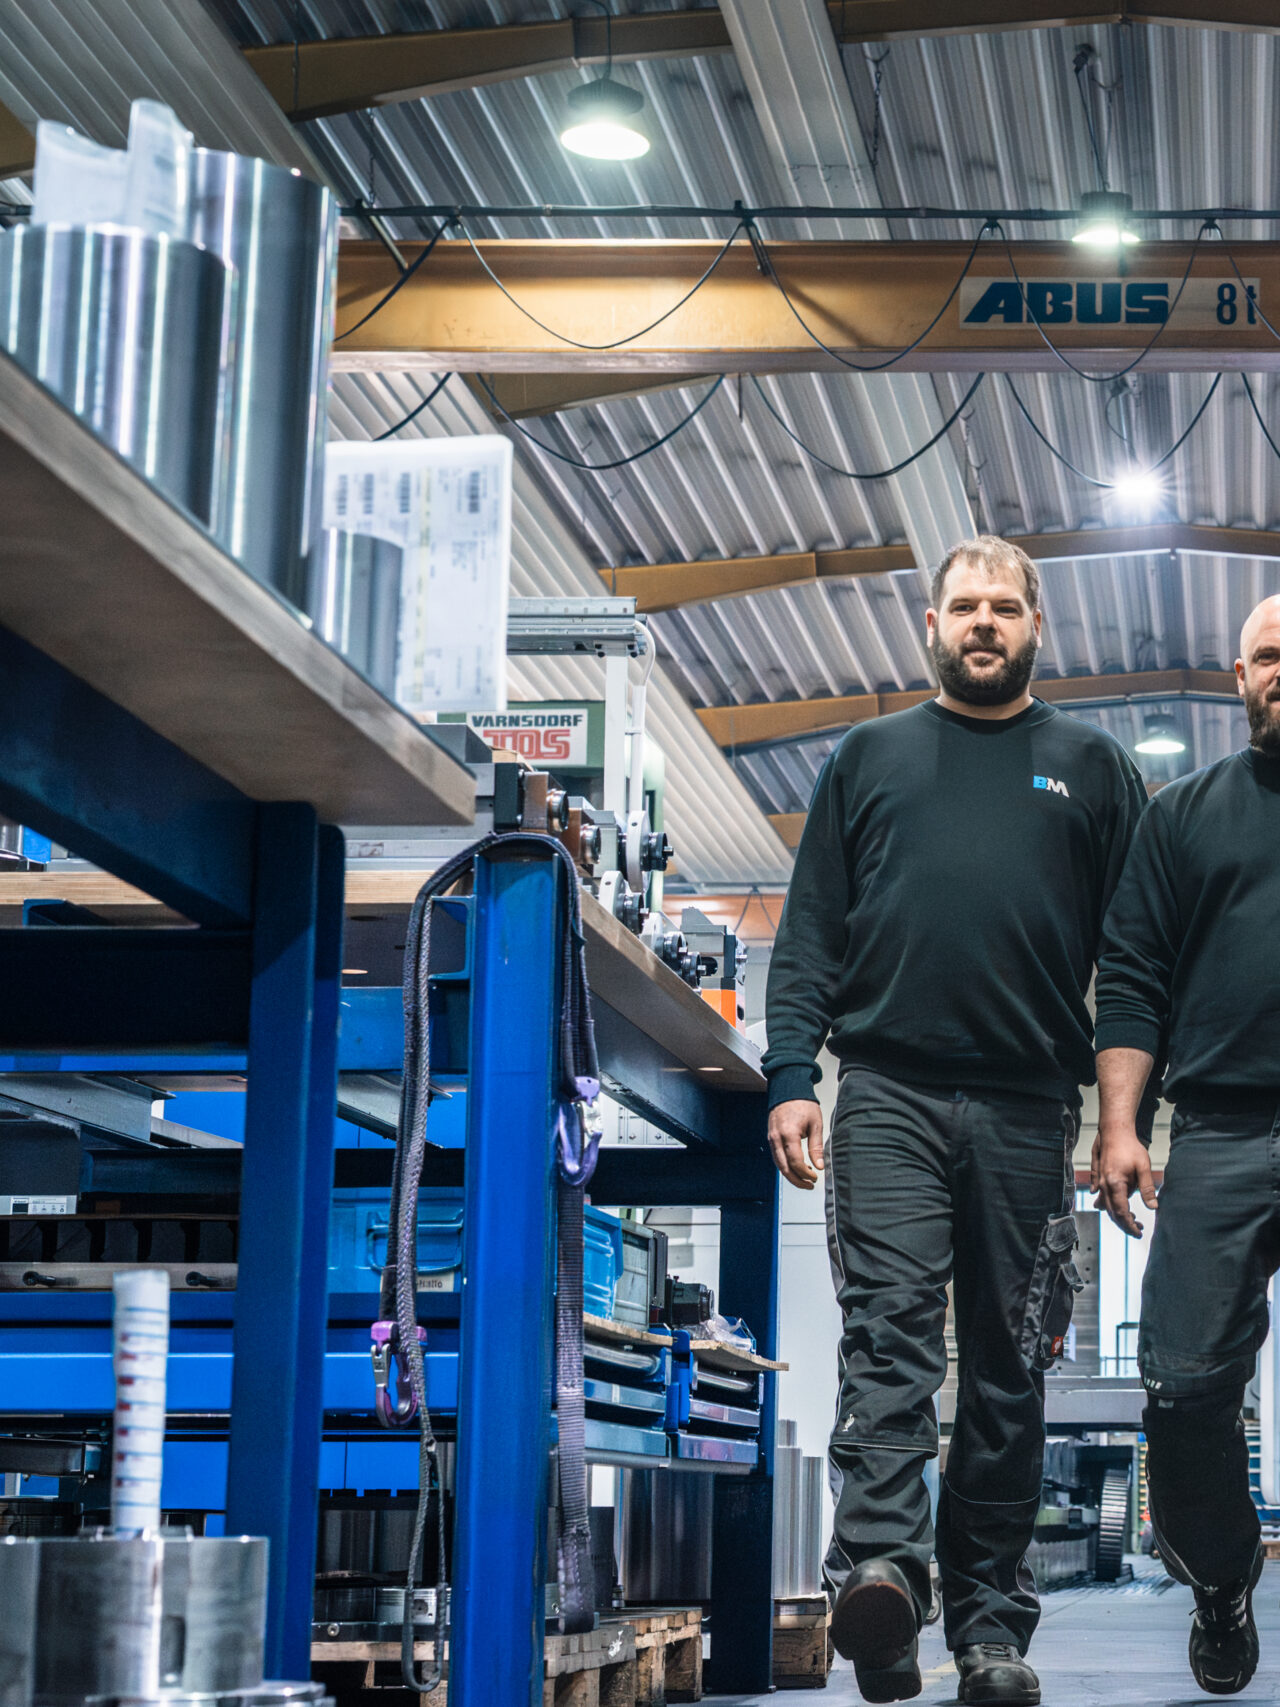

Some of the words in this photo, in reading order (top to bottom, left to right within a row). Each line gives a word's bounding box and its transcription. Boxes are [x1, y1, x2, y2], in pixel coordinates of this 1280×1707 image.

[963, 282, 1169, 324] ABUS
[472, 714, 583, 727] VARNSDORF
[483, 729, 570, 760] TOS
[1033, 775, 1069, 798] BM
